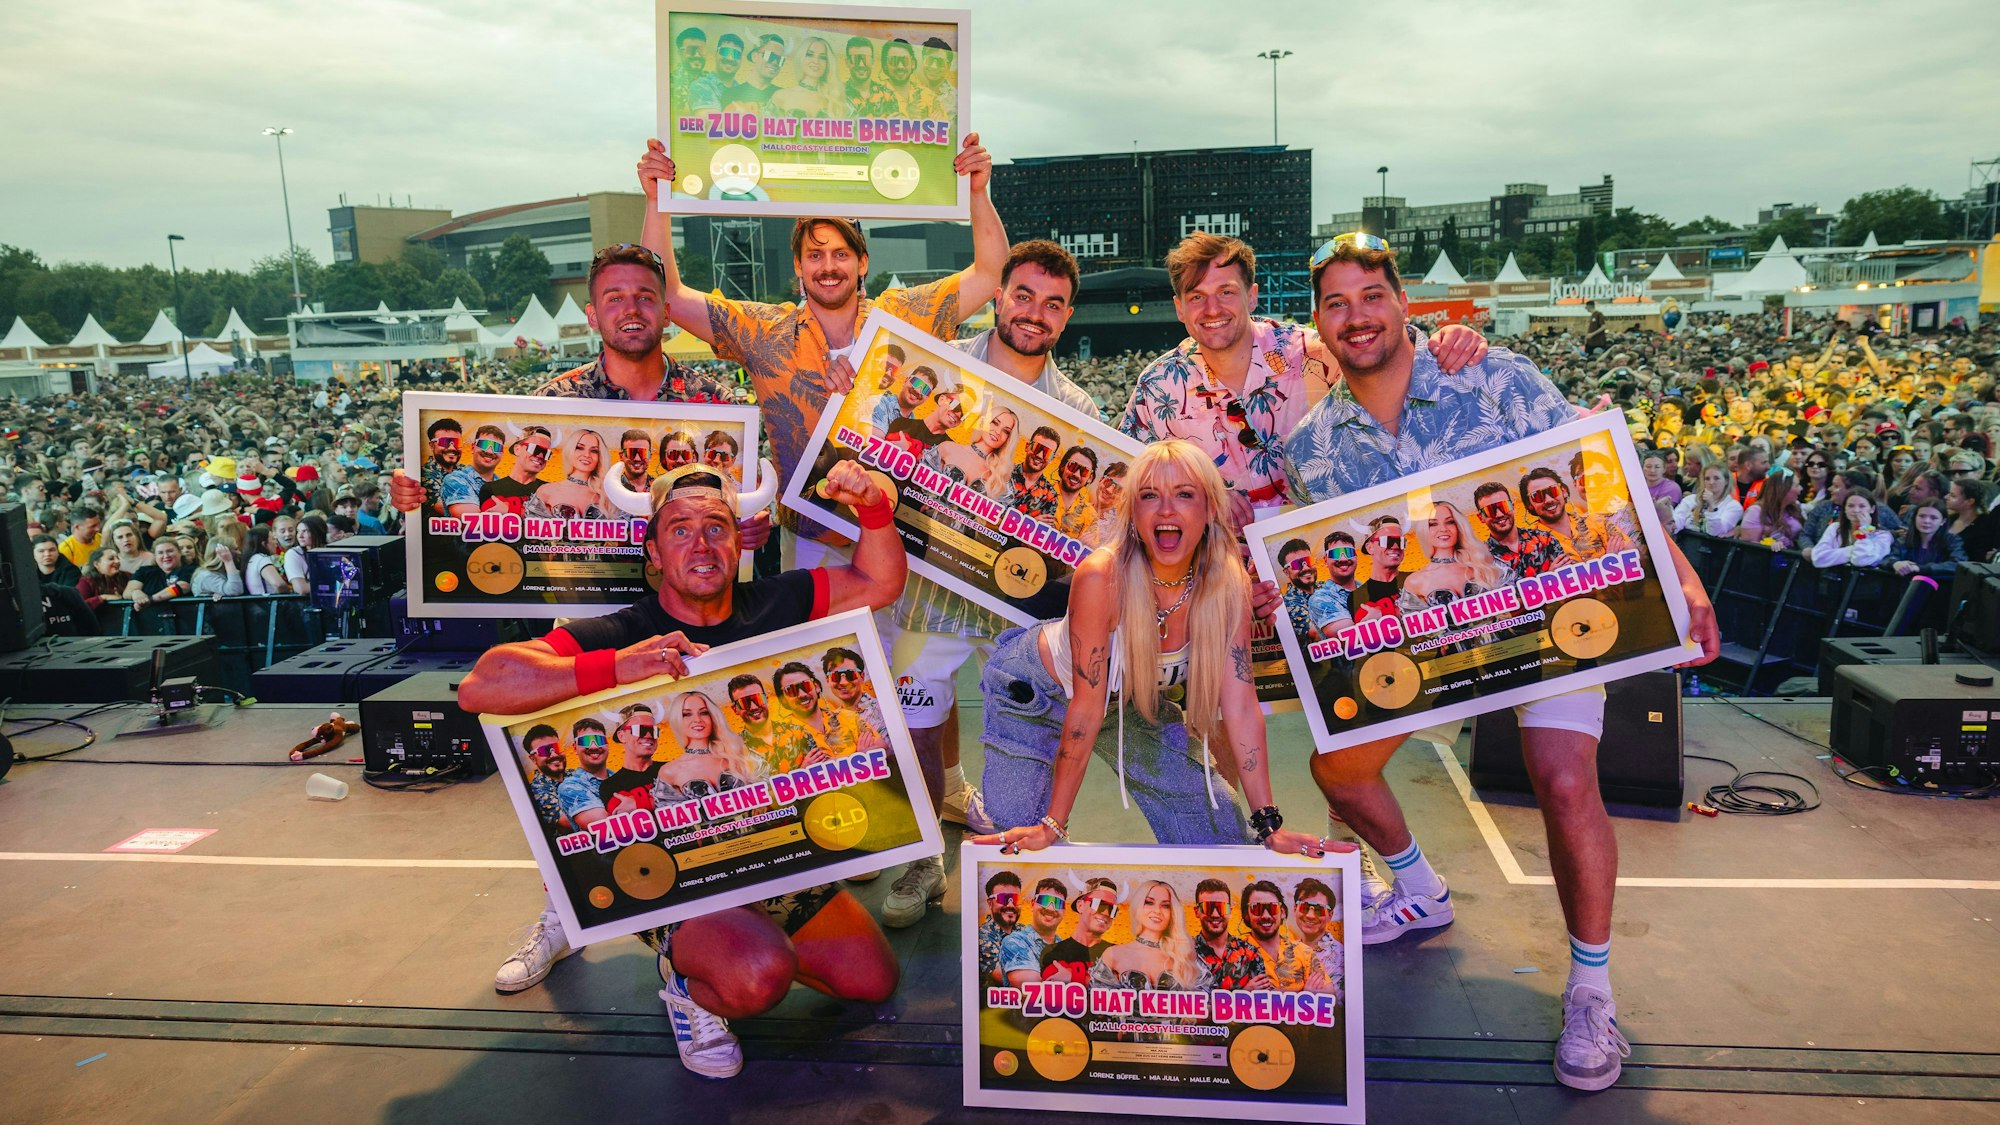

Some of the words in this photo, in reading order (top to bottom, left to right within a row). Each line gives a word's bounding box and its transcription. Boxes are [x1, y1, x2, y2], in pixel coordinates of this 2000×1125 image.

[679, 117, 704, 132] DER
[707, 112, 757, 139] ZUG
[763, 118, 797, 136] HAT
[802, 119, 853, 138] KEINE
[858, 118, 949, 143] BREMSE
[834, 145, 870, 154] EDITION)
[1550, 275, 1647, 300] Krombacher
[1415, 308, 1450, 324] PEROL
[837, 427, 864, 450] DER
[860, 437, 915, 480] ZUG
[913, 466, 950, 494] HAT
[950, 485, 1003, 523] KEINE
[432, 519, 460, 534] DER
[463, 514, 520, 541] ZUG
[527, 520, 563, 538] HAT
[570, 521, 627, 539] KEINE
[903, 486, 973, 528] (MALLORCASTYLE
[971, 521, 1008, 546] EDITION)
[523, 544, 603, 554] (MALLORCASTYLE
[604, 547, 644, 556] EDITION)
[930, 545, 940, 553] MIA
[939, 549, 953, 561] JULIA
[959, 560, 976, 572] MALLE
[975, 568, 989, 579] ANJA
[467, 561, 523, 575] GOLD
[1311, 640, 1340, 661] DER
[1338, 615, 1402, 656] ZUG
[1405, 608, 1447, 637] HAT
[1450, 590, 1517, 626] KEINE
[1519, 551, 1642, 609] BREMSE
[1411, 621, 1499, 654] (MALLORCASTYLE
[1497, 610, 1546, 630] EDITION)
[1424, 685, 1450, 695] LORENZ
[1450, 679, 1474, 690] BÜFFEL
[1480, 673, 1493, 681] MIA
[1493, 668, 1512, 678] JULIA
[1519, 660, 1542, 671] MALLE
[1542, 656, 1560, 665] ANJA
[895, 687, 927, 697] ALLE
[900, 696, 934, 707] NJA
[560, 833, 592, 854] DER
[591, 811, 656, 851] ZUG
[658, 801, 700, 829] HAT
[701, 784, 769, 818] KEINE
[773, 751, 888, 803] BREMSE
[664, 816, 752, 850] (MALLORCASTYLE
[751, 806, 798, 826] EDITION)
[679, 879, 705, 888] LORENZ
[705, 872, 729, 883] BÜFFEL
[748, 862, 766, 871] JULIA
[773, 854, 794, 864] MALLE
[795, 850, 812, 858] ANJA
[990, 988, 1019, 1006] DER
[1024, 983, 1086, 1016] ZUG
[1093, 990, 1134, 1013] HAT
[1142, 991, 1206, 1017] KEINE
[1215, 992, 1334, 1025] BREMSE
[1089, 1020, 1181, 1034] (MALLORCASTYLE
[1183, 1025, 1229, 1038] EDITION)
[1089, 1071, 1115, 1080] LORENZ
[1116, 1072, 1140, 1081] BÜFFEL
[1189, 1076, 1211, 1084] MALLE
[1212, 1077, 1230, 1085] ANJA
